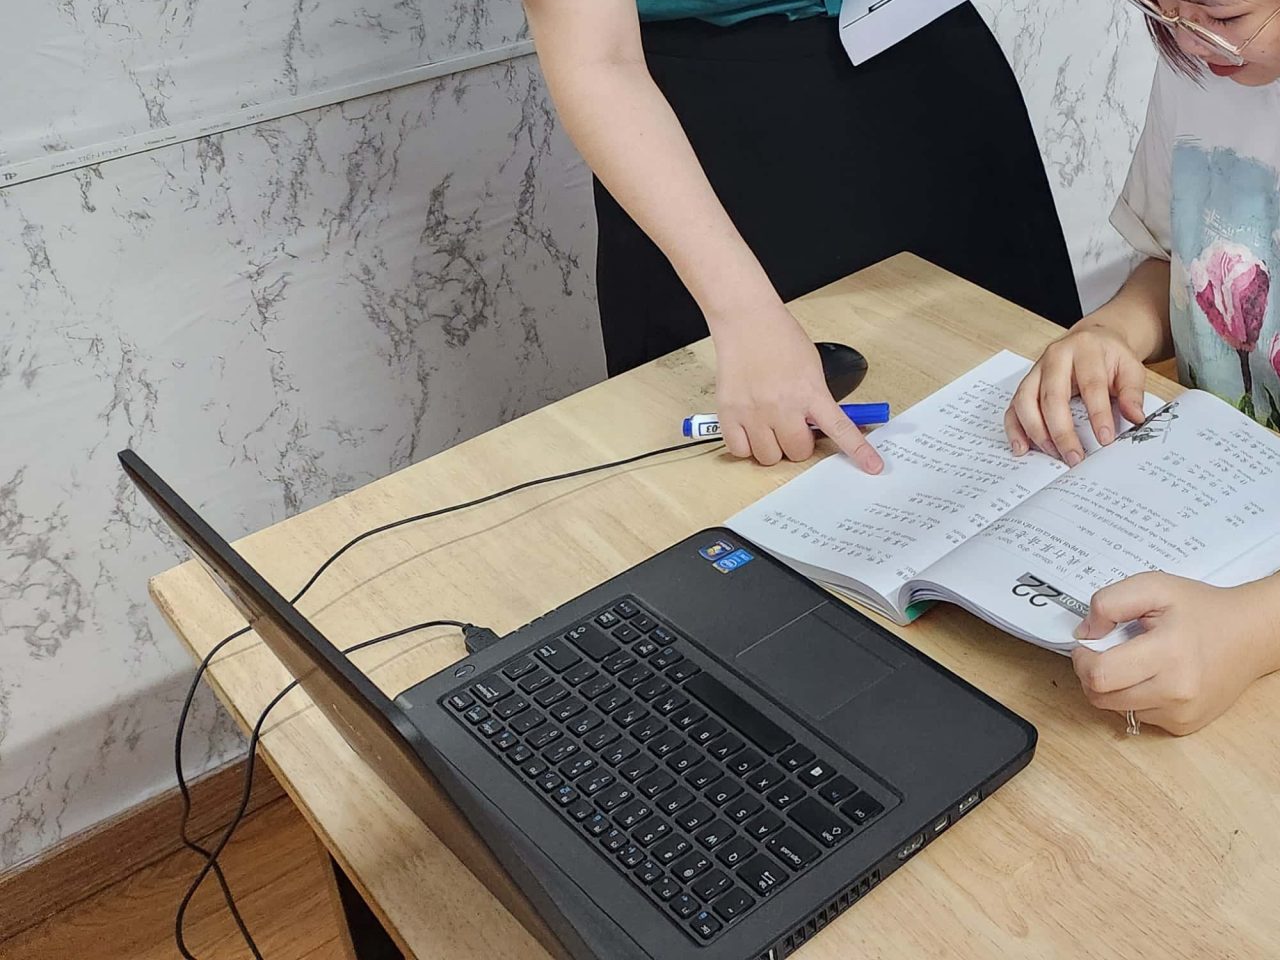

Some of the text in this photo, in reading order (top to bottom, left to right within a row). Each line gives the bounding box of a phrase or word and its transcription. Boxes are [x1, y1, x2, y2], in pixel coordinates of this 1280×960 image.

[1012, 574, 1063, 607] 22
[663, 702, 673, 710] M
[706, 836, 717, 844] W
[729, 853, 737, 861] Q
